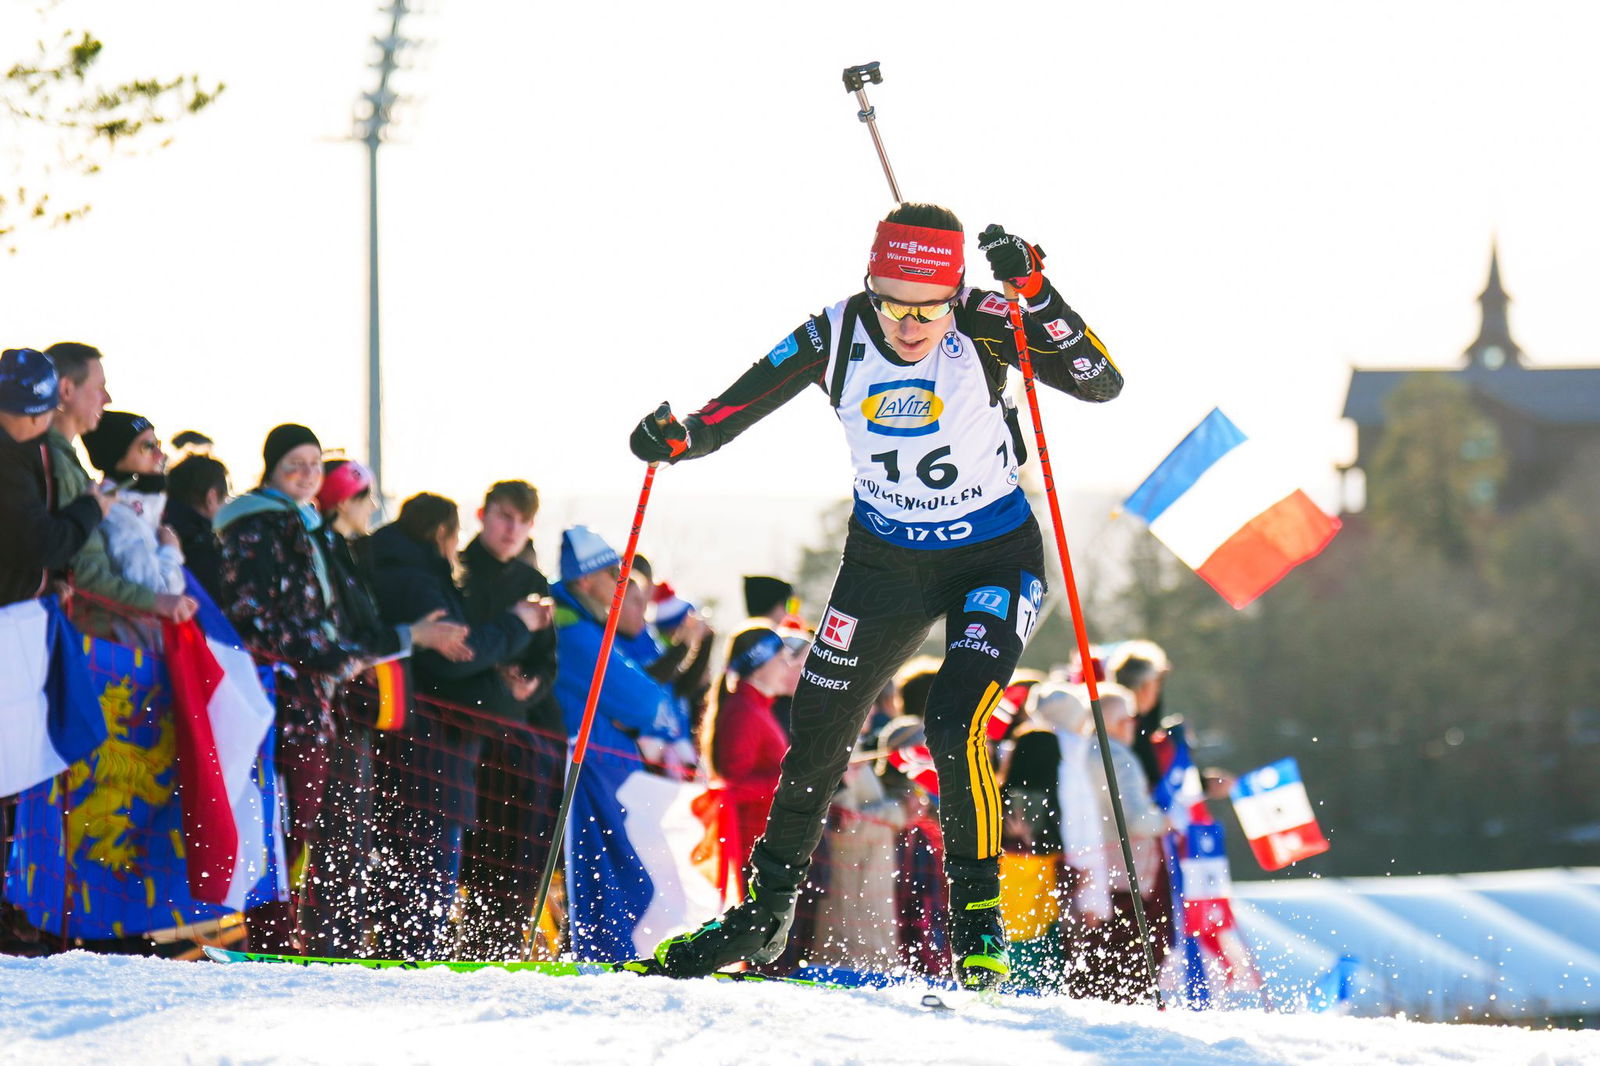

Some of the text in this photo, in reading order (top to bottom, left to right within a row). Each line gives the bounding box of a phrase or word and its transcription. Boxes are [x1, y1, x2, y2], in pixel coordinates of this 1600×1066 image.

[889, 241, 952, 256] VIESSMANN
[887, 252, 950, 267] Wärmepumpen
[871, 445, 959, 490] 16
[804, 670, 851, 691] TERREX
